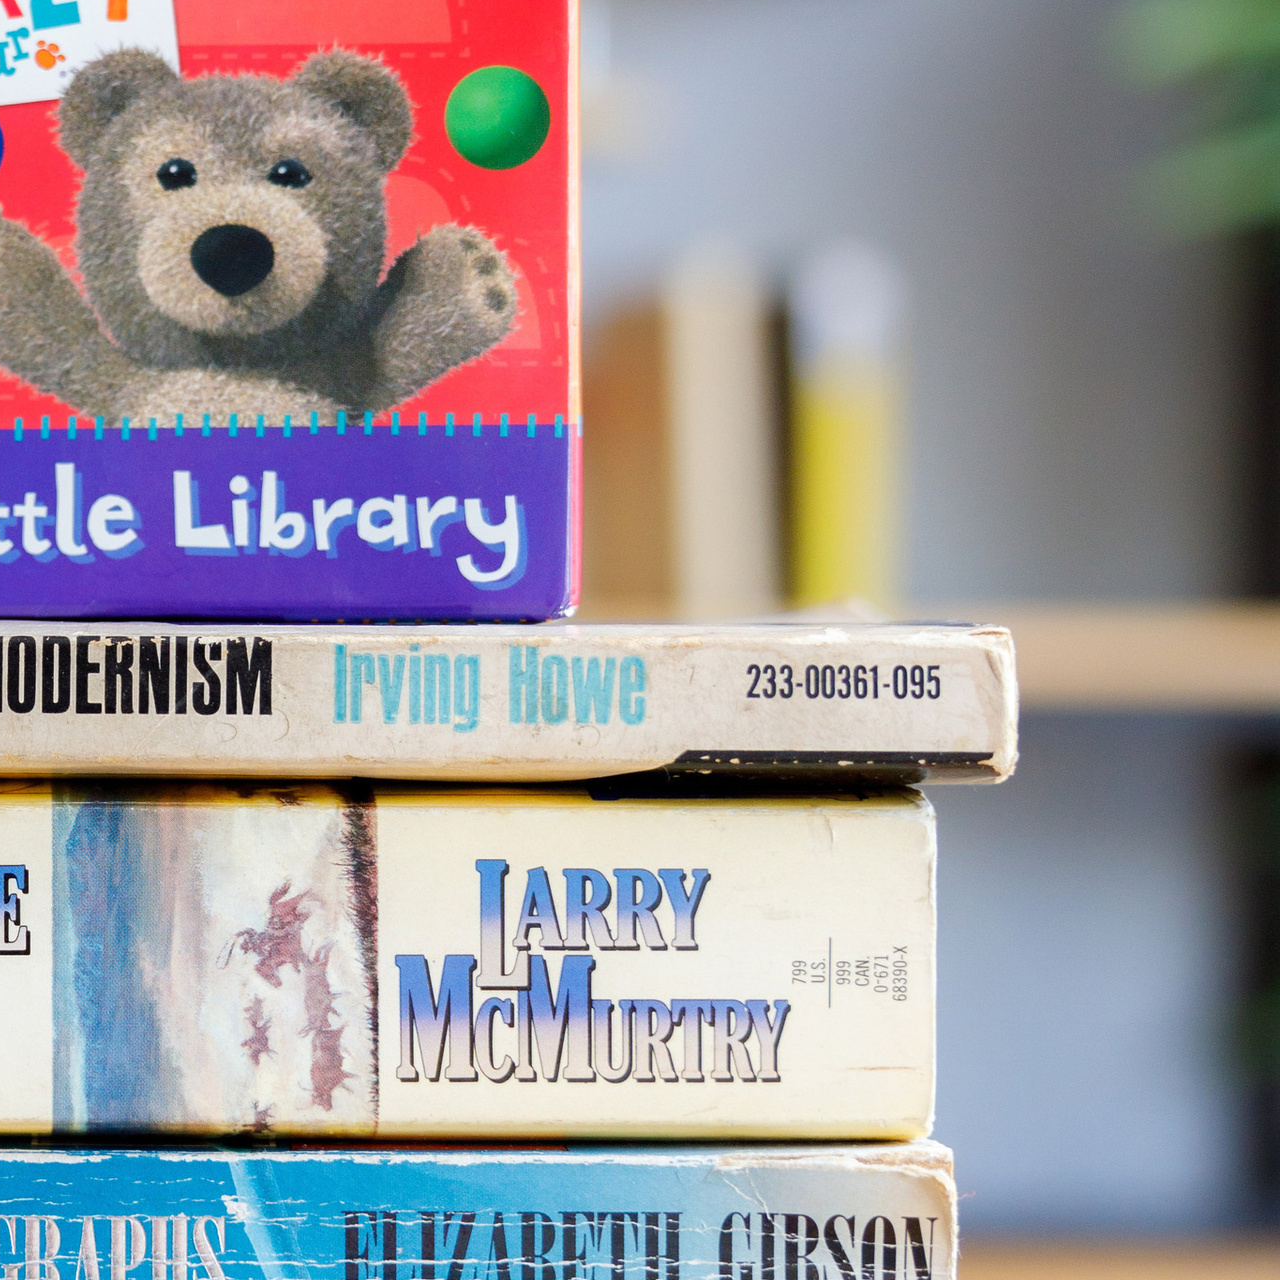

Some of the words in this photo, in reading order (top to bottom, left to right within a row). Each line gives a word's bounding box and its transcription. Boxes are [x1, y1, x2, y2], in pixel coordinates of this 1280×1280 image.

[173, 470, 522, 584] Library
[332, 643, 482, 733] Irving
[508, 644, 647, 726] Howe
[745, 663, 942, 701] 233-00361-095
[475, 858, 711, 990] LARRY
[791, 960, 807, 985] 799
[810, 958, 826, 984] U.S.
[835, 960, 851, 986] 999
[854, 955, 870, 987] CAN.
[873, 955, 889, 994] 0-671
[892, 945, 908, 1002] 68390-X
